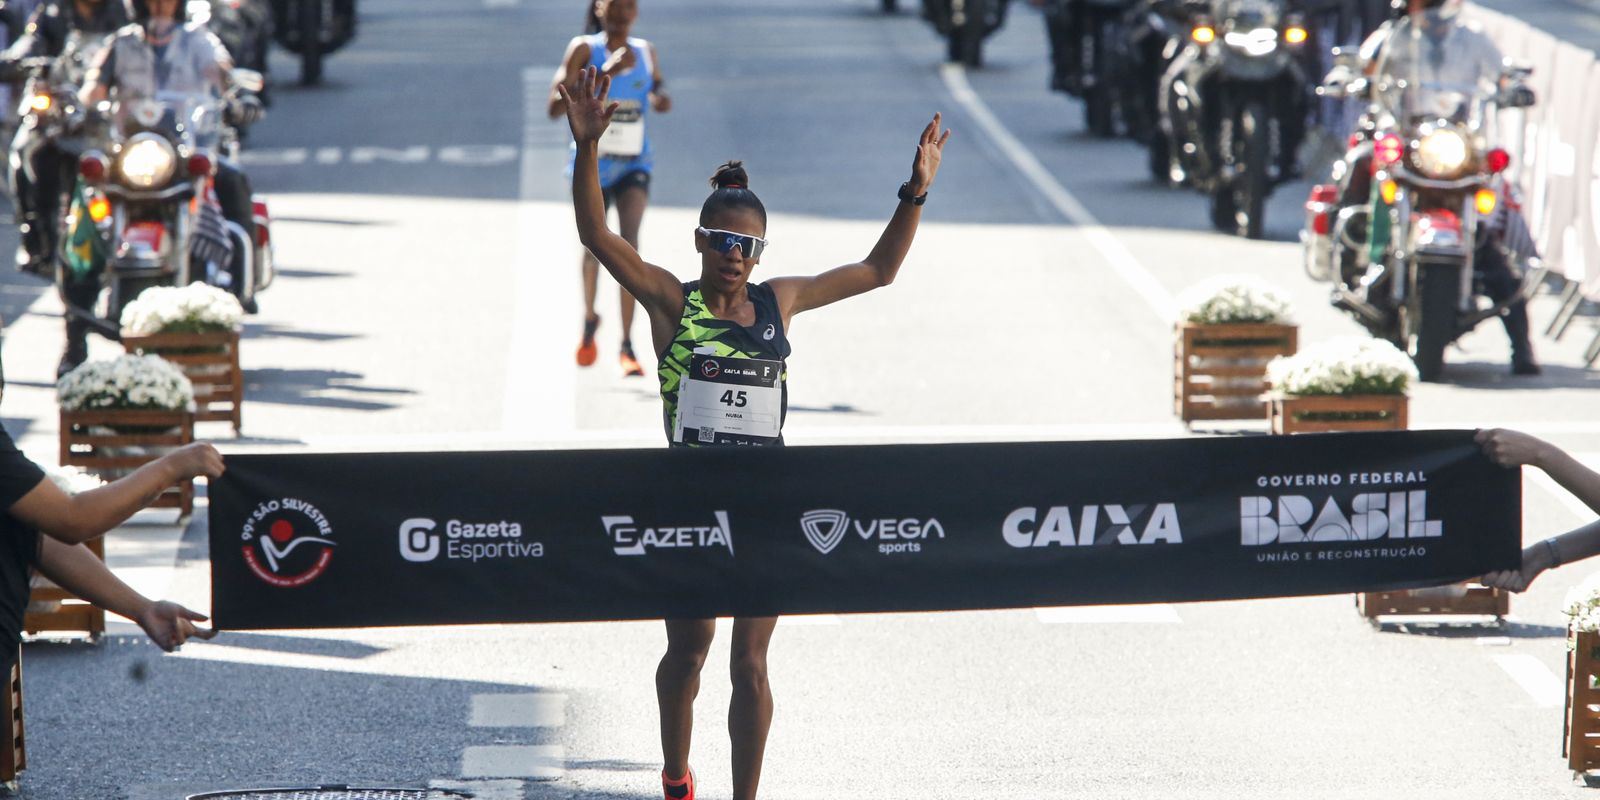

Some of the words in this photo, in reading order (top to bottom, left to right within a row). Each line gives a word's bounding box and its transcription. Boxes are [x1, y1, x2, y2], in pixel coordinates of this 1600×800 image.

[763, 366, 770, 377] F
[720, 389, 747, 408] 45
[1257, 473, 1342, 487] GOVERNO
[1350, 471, 1427, 485] FEDERAL
[253, 500, 280, 521] SÃO
[282, 498, 333, 536] SILVESTRE
[1002, 503, 1183, 548] CAIXA
[1240, 490, 1443, 545] BRASIL
[446, 519, 522, 538] Gazeta
[601, 511, 734, 557] GAZETA
[854, 518, 945, 540] VEGA
[447, 539, 544, 562] Esportiva
[878, 541, 921, 555] sports
[1257, 551, 1300, 562] UNIÃO
[1305, 552, 1313, 561] E
[1318, 547, 1427, 561] RECONSTRUÇÃO
